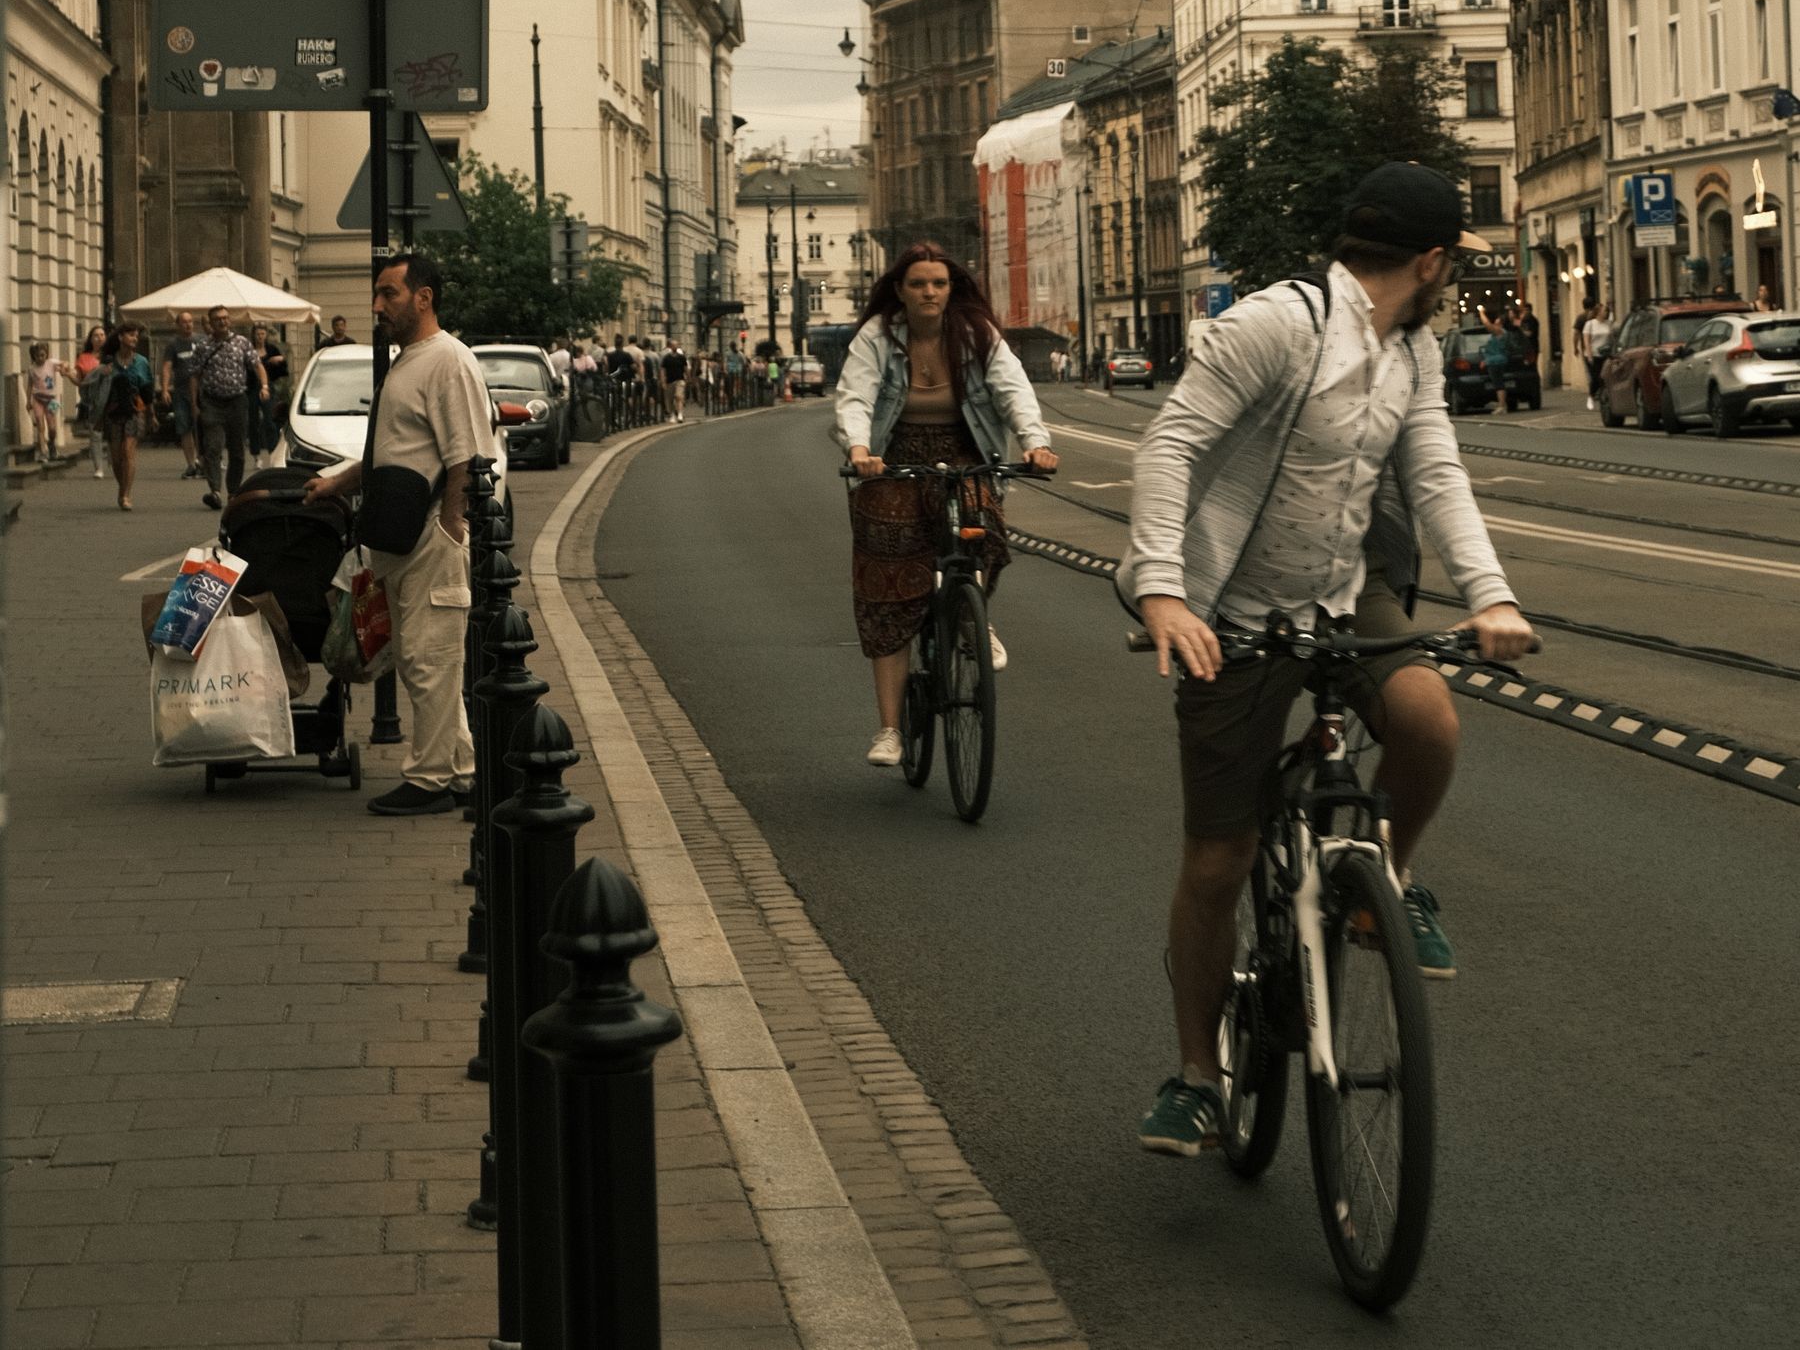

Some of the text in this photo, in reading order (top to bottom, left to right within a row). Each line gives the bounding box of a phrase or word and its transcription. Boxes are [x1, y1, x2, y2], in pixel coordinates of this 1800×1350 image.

[1048, 61, 1064, 75] 30
[1641, 177, 1666, 211] P
[157, 670, 250, 695] PRIMARK
